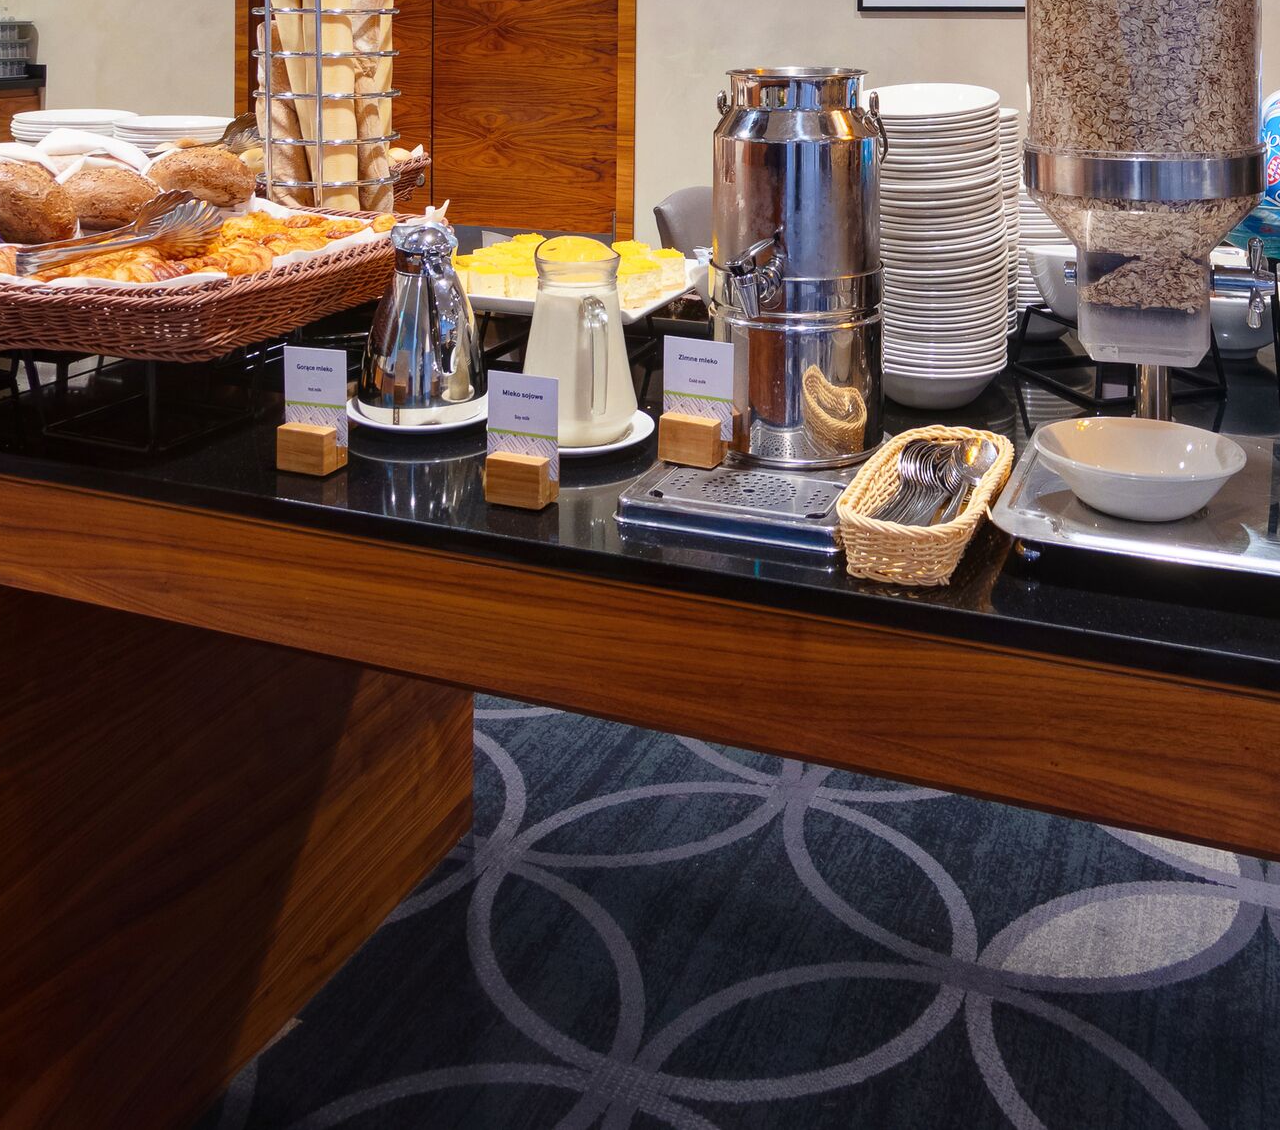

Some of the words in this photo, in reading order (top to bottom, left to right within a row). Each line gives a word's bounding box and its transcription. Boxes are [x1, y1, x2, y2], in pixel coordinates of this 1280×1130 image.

[678, 353, 698, 362] Zimne
[698, 357, 718, 365] mleko
[296, 363, 315, 371] Gorące
[502, 389, 520, 398] Mleko
[521, 392, 543, 400] sojowe
